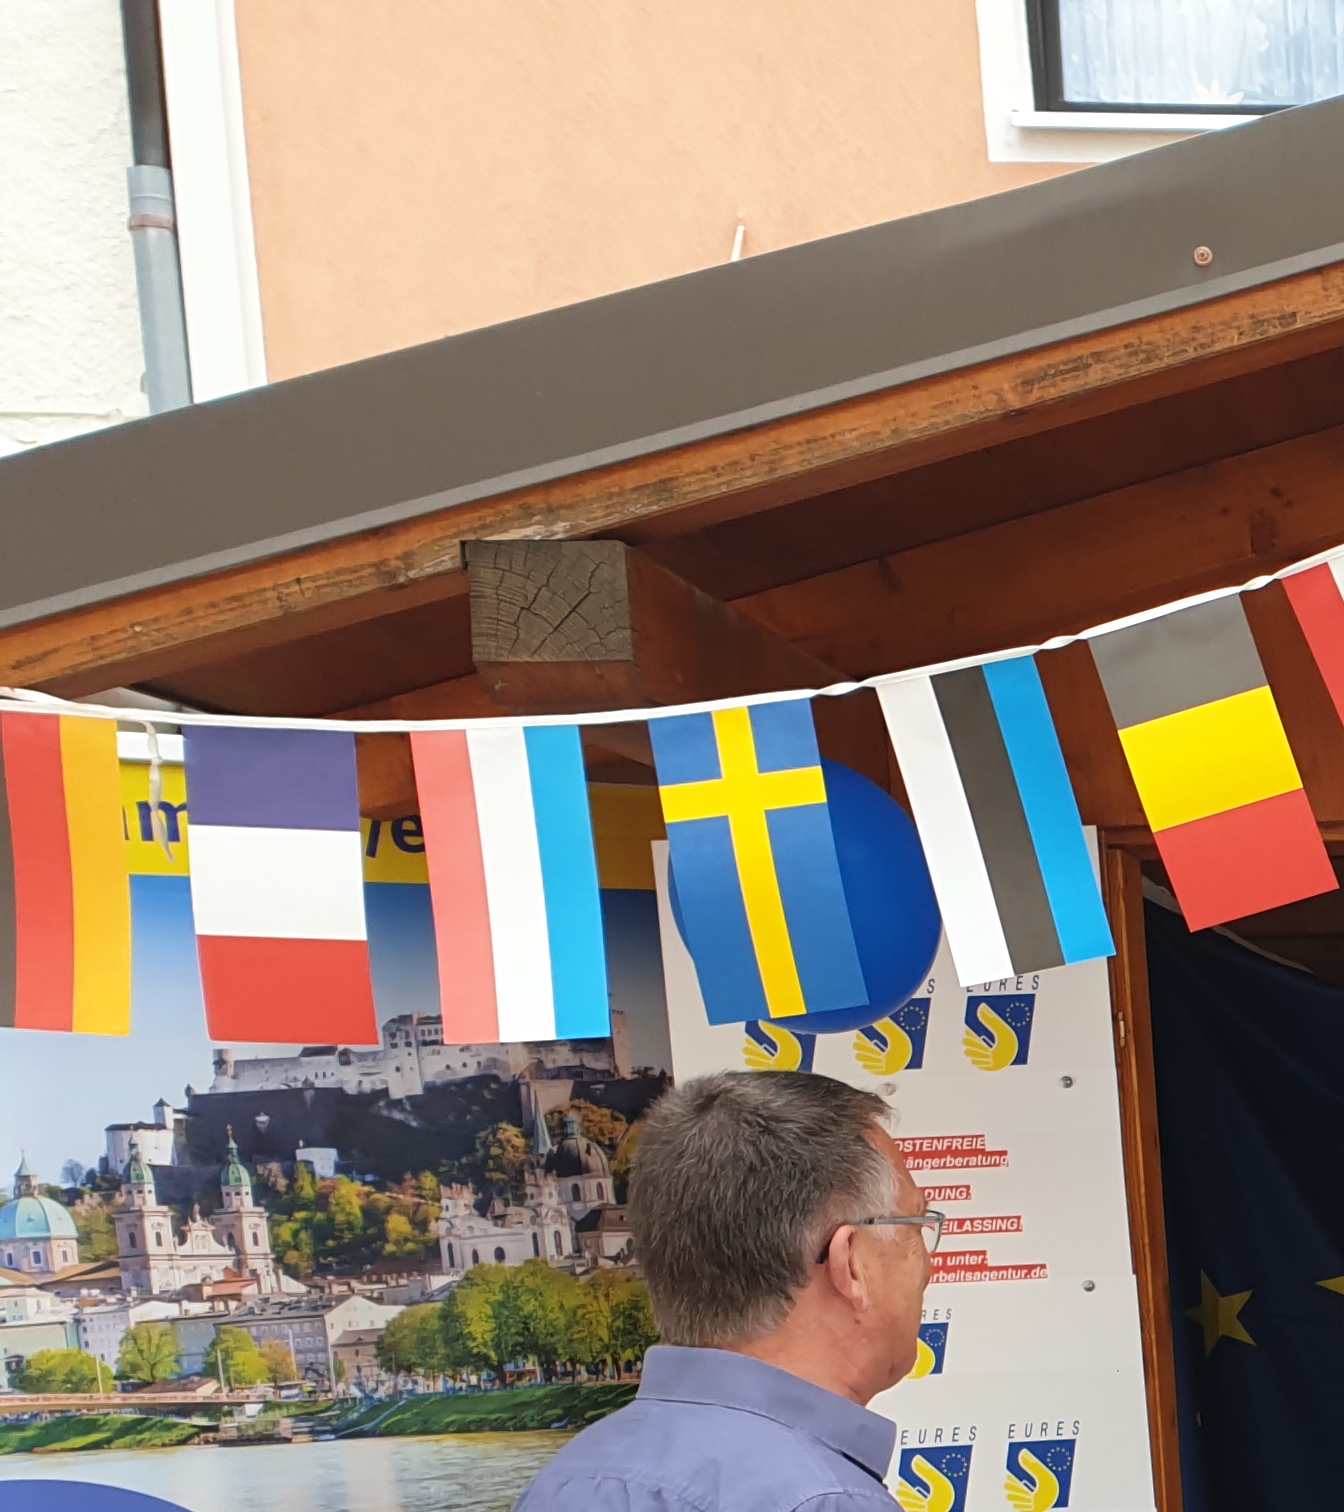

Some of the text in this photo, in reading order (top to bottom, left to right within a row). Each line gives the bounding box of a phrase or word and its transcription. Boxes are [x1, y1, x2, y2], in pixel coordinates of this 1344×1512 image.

[895, 1137, 986, 1152] OSTENFREIE
[903, 1154, 1009, 1170] ängerberatung
[925, 1188, 971, 1200] DUNG:
[941, 1219, 1023, 1233] EILASSING!
[901, 1426, 978, 1445] EURES
[1008, 1420, 1081, 1439] EURES
